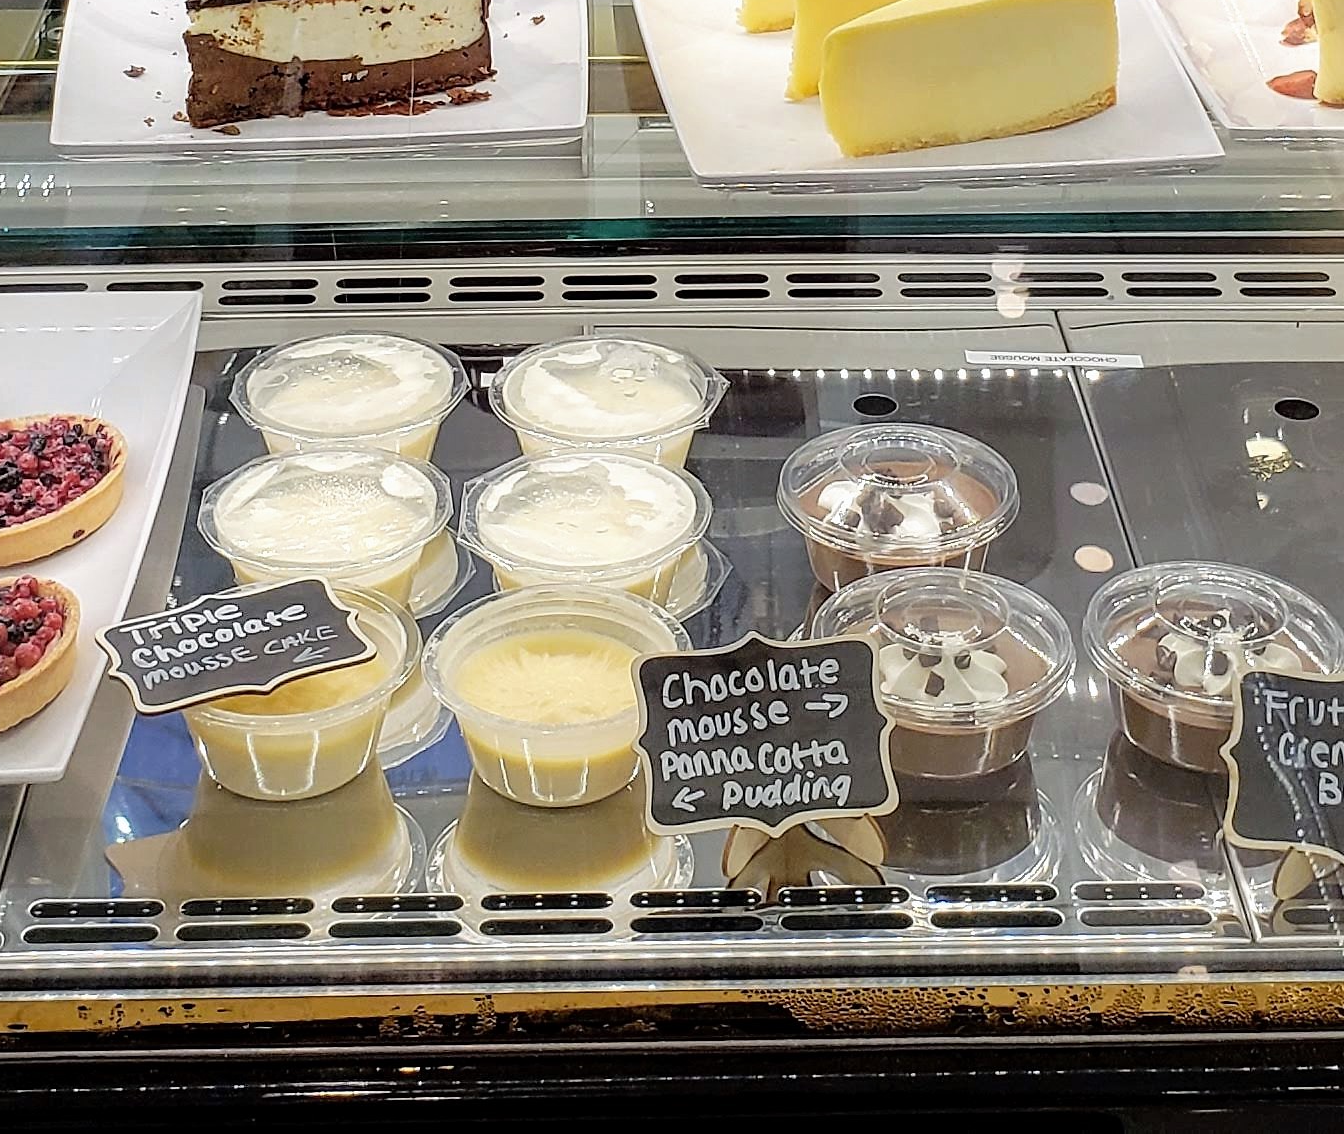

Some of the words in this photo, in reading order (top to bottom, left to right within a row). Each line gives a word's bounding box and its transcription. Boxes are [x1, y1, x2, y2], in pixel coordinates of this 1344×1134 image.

[989, 355, 1042, 363] MOUSSE
[1044, 355, 1118, 364] CHOCOLATE
[119, 602, 243, 646] Triple
[131, 603, 309, 670] Chocolate
[263, 625, 339, 656] CAKE
[662, 658, 840, 709] Chocolate
